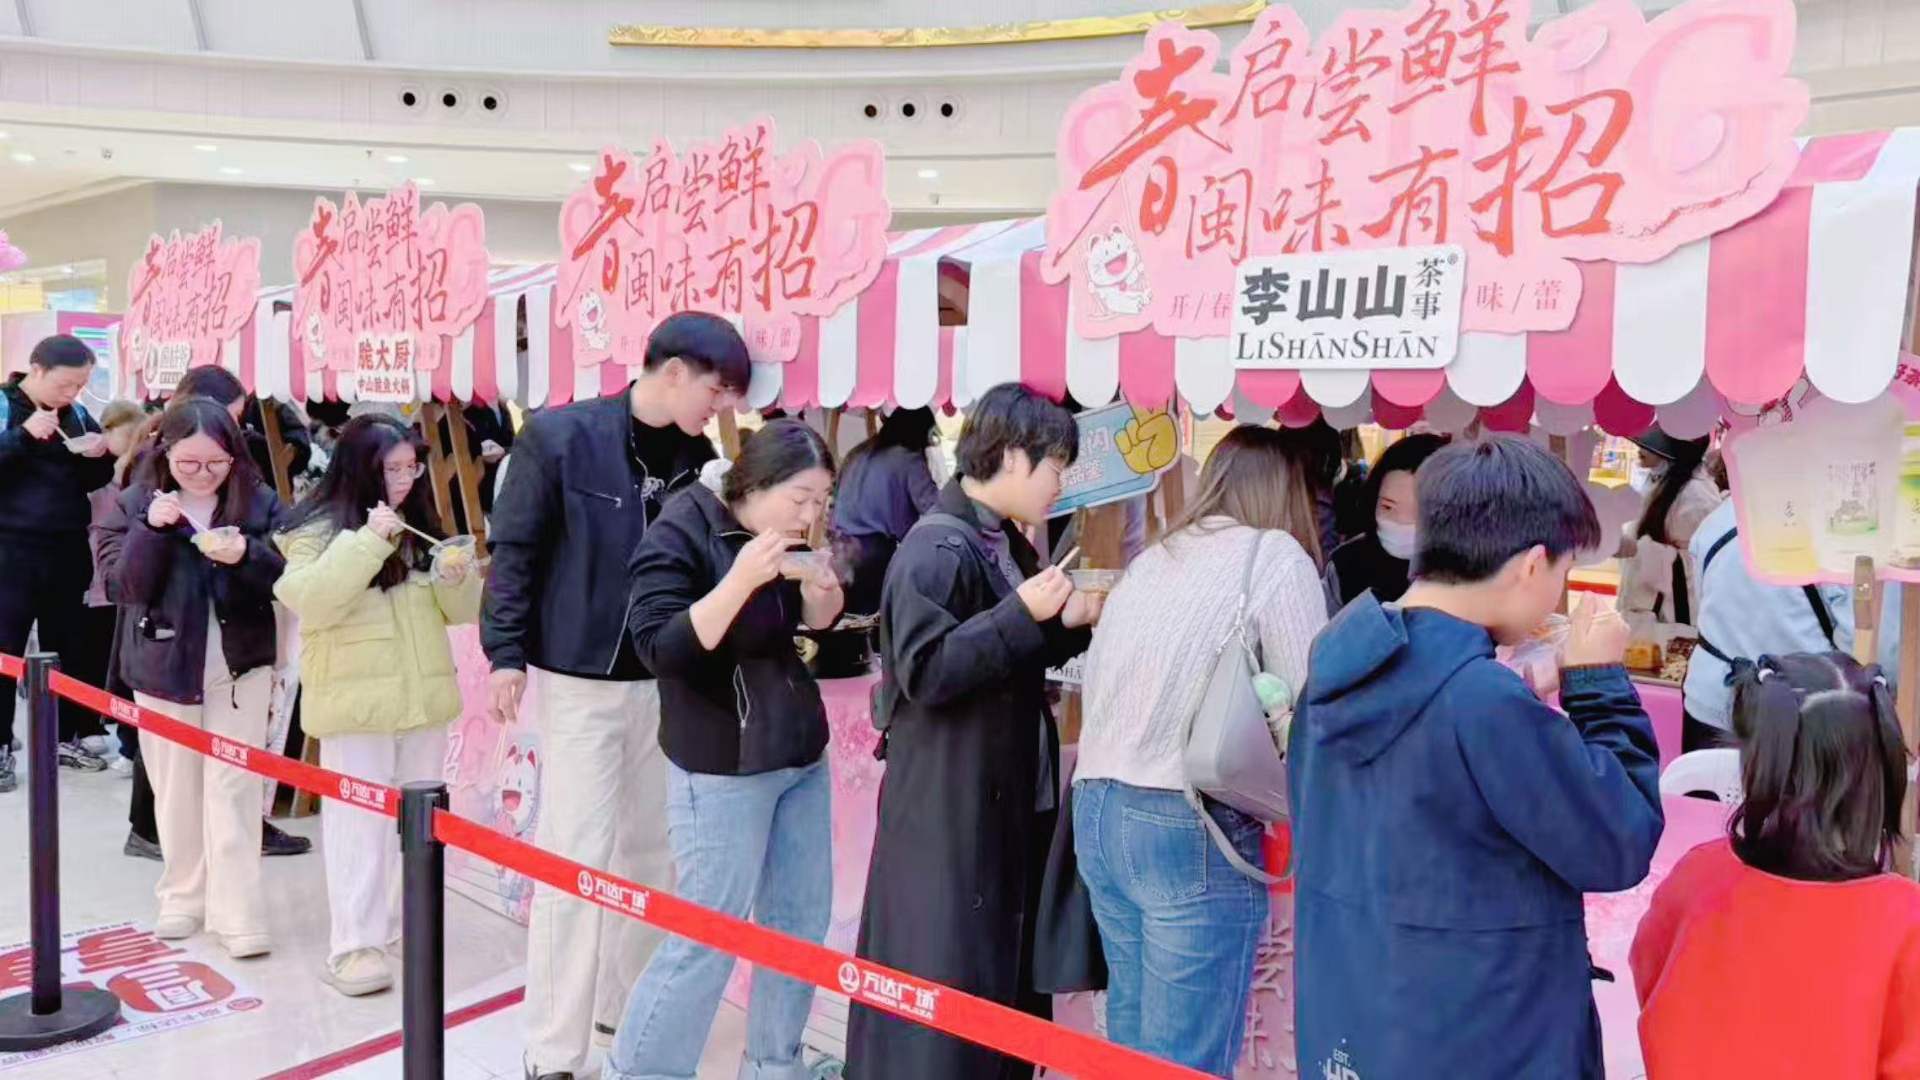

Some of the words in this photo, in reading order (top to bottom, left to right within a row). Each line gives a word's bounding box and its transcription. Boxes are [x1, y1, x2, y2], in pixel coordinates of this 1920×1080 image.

[1052, 0, 1521, 267] 春启尝鲜
[1185, 88, 1634, 267] 闽味有招
[300, 189, 418, 320] 春启尝鲜
[562, 126, 770, 313] 春启尝鲜
[624, 200, 819, 318] 闽味有招
[333, 248, 448, 335] 闽味有招
[1240, 265, 1408, 325] 李山山
[1410, 257, 1445, 321] 茶事
[595, 876, 647, 911] 万达广场
[862, 970, 936, 1012] 万达广场
